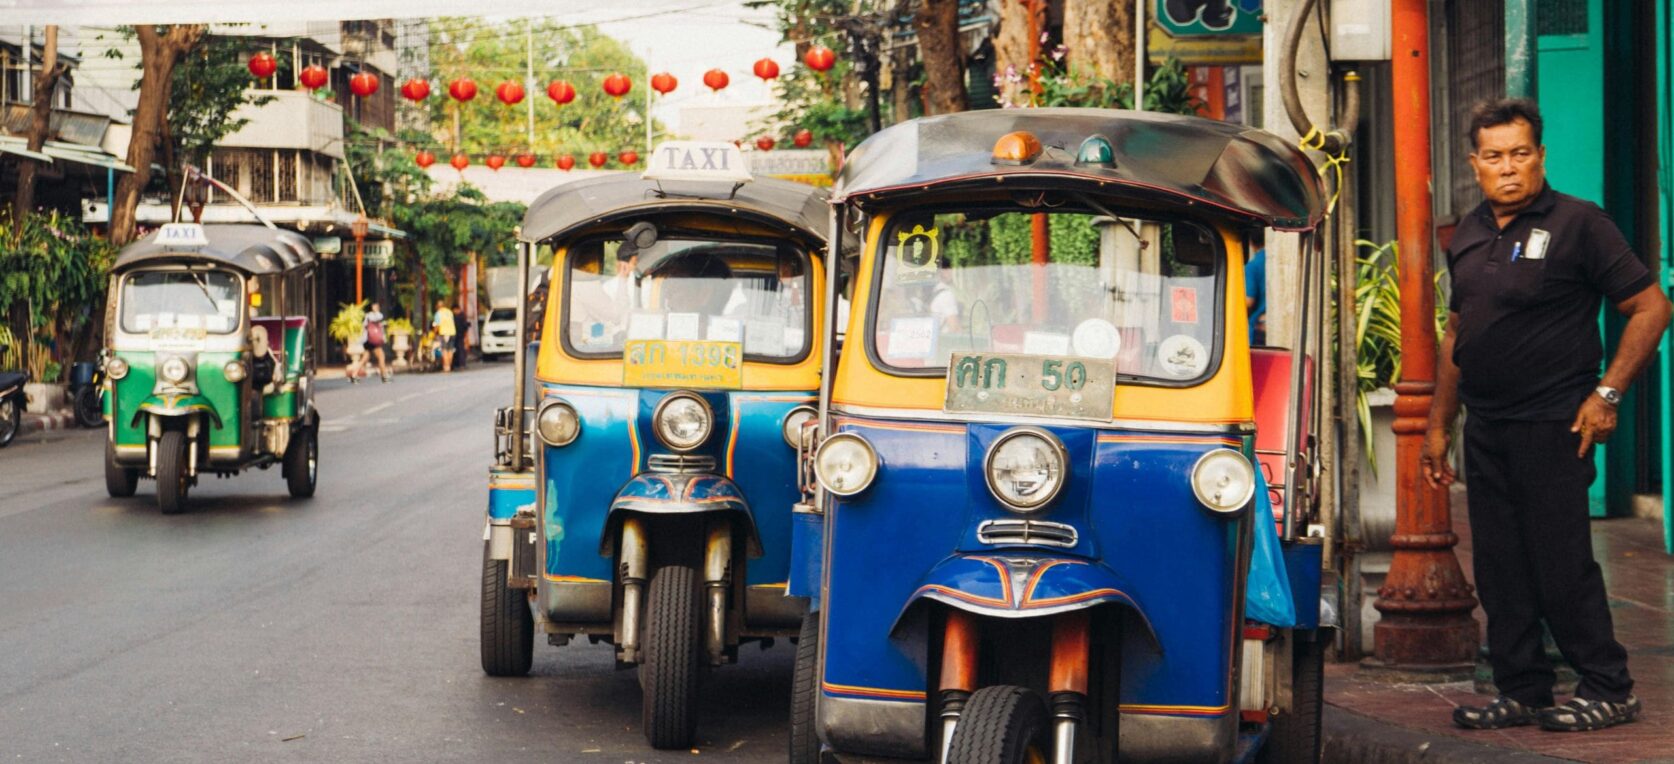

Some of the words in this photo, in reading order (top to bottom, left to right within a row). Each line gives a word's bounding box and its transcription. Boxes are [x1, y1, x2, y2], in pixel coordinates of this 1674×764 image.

[662, 147, 731, 170] TAXI
[165, 227, 196, 239] TAXI
[1041, 359, 1087, 392] 50
